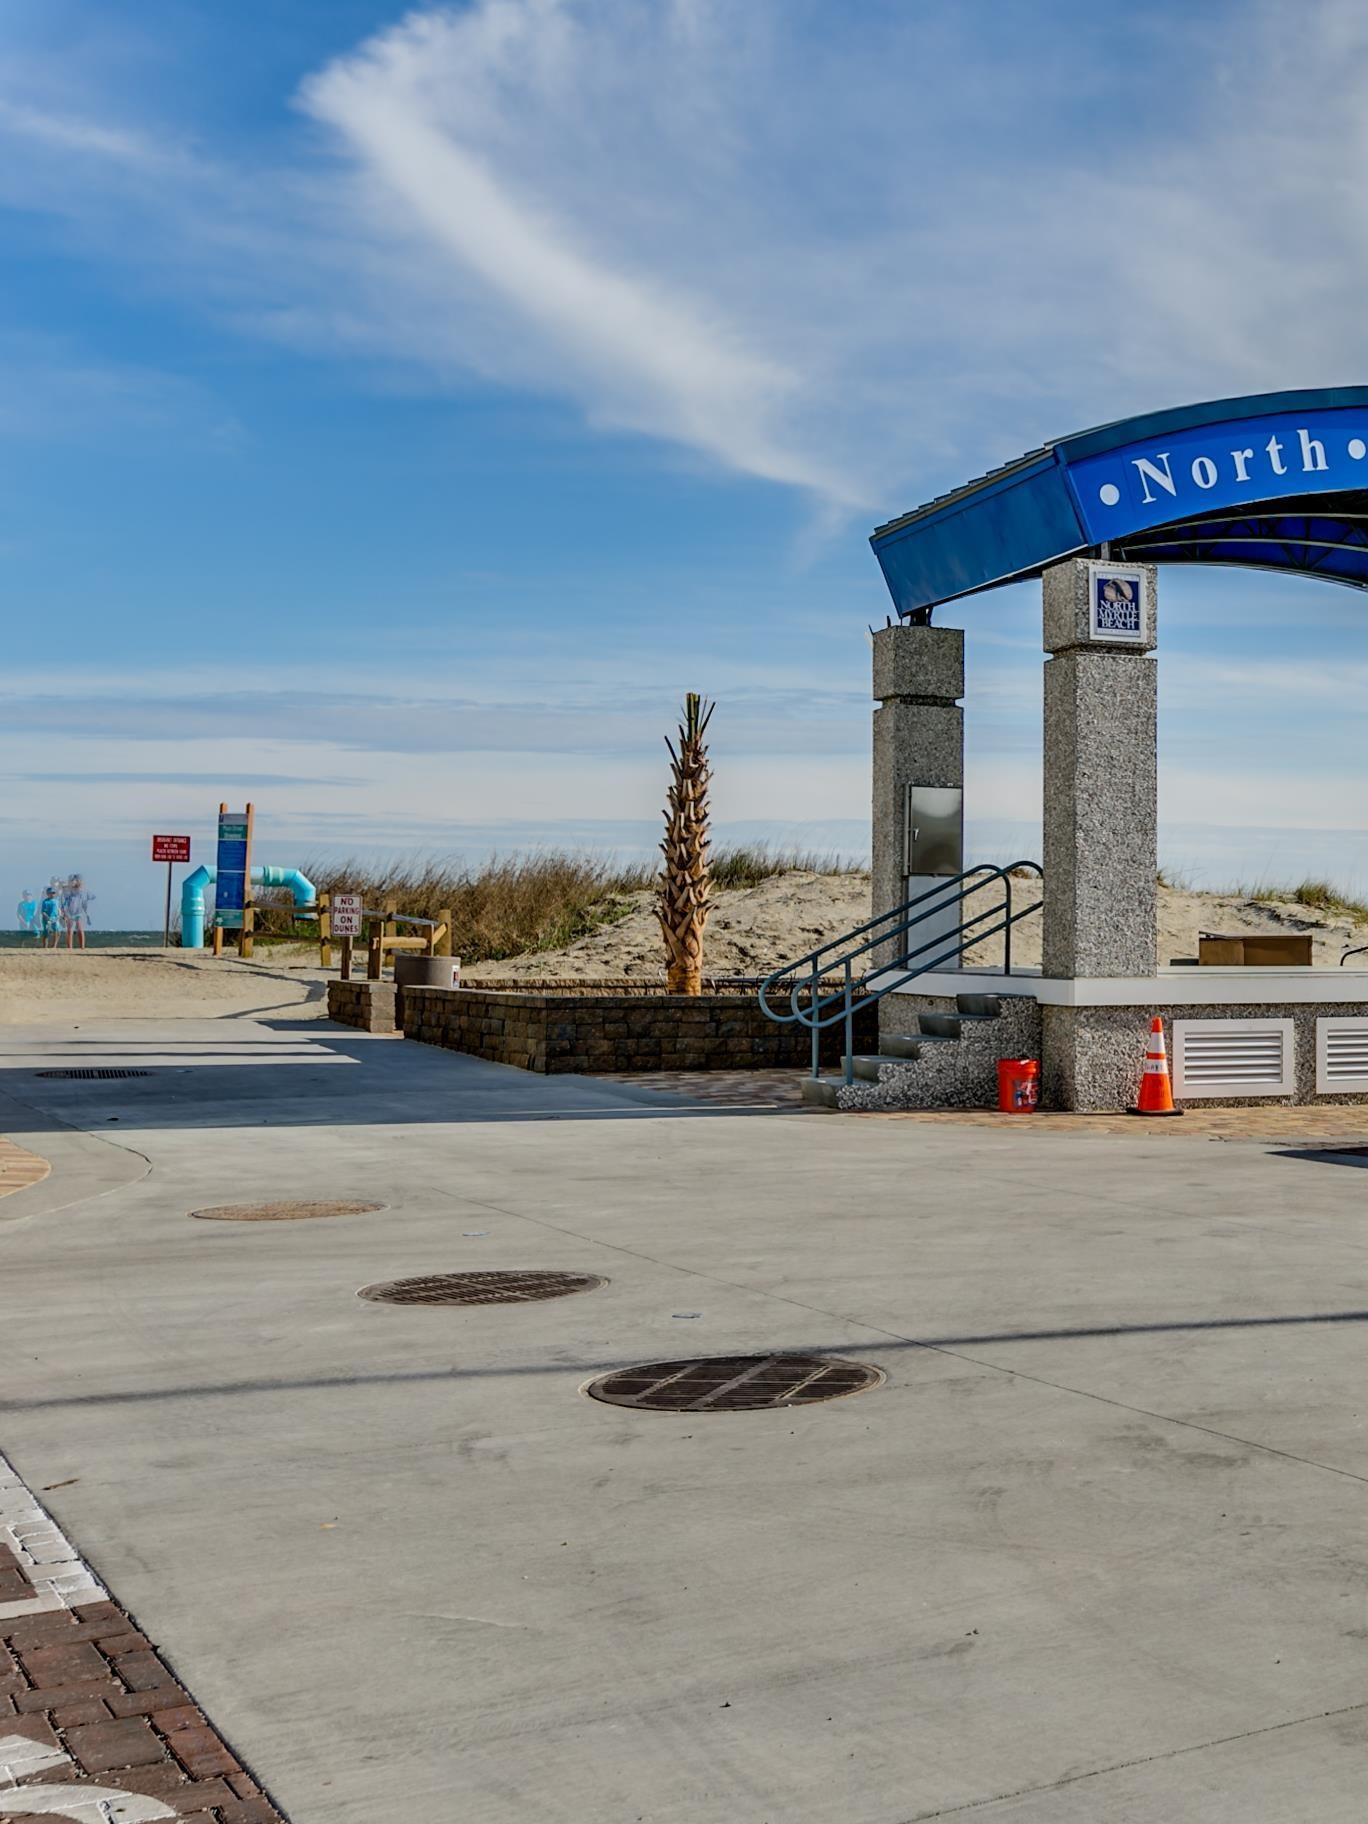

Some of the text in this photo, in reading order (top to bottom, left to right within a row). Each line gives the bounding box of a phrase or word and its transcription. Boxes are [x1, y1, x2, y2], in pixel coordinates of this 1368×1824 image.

[1132, 429, 1329, 504] North
[1100, 600, 1135, 612] NORTH
[1097, 608, 1140, 621] MYRTLE
[1102, 618, 1135, 629] BEACH
[341, 898, 354, 906] NO
[334, 907, 360, 915] PARKING
[340, 915, 353, 924] ON
[334, 925, 359, 933] DUNES
